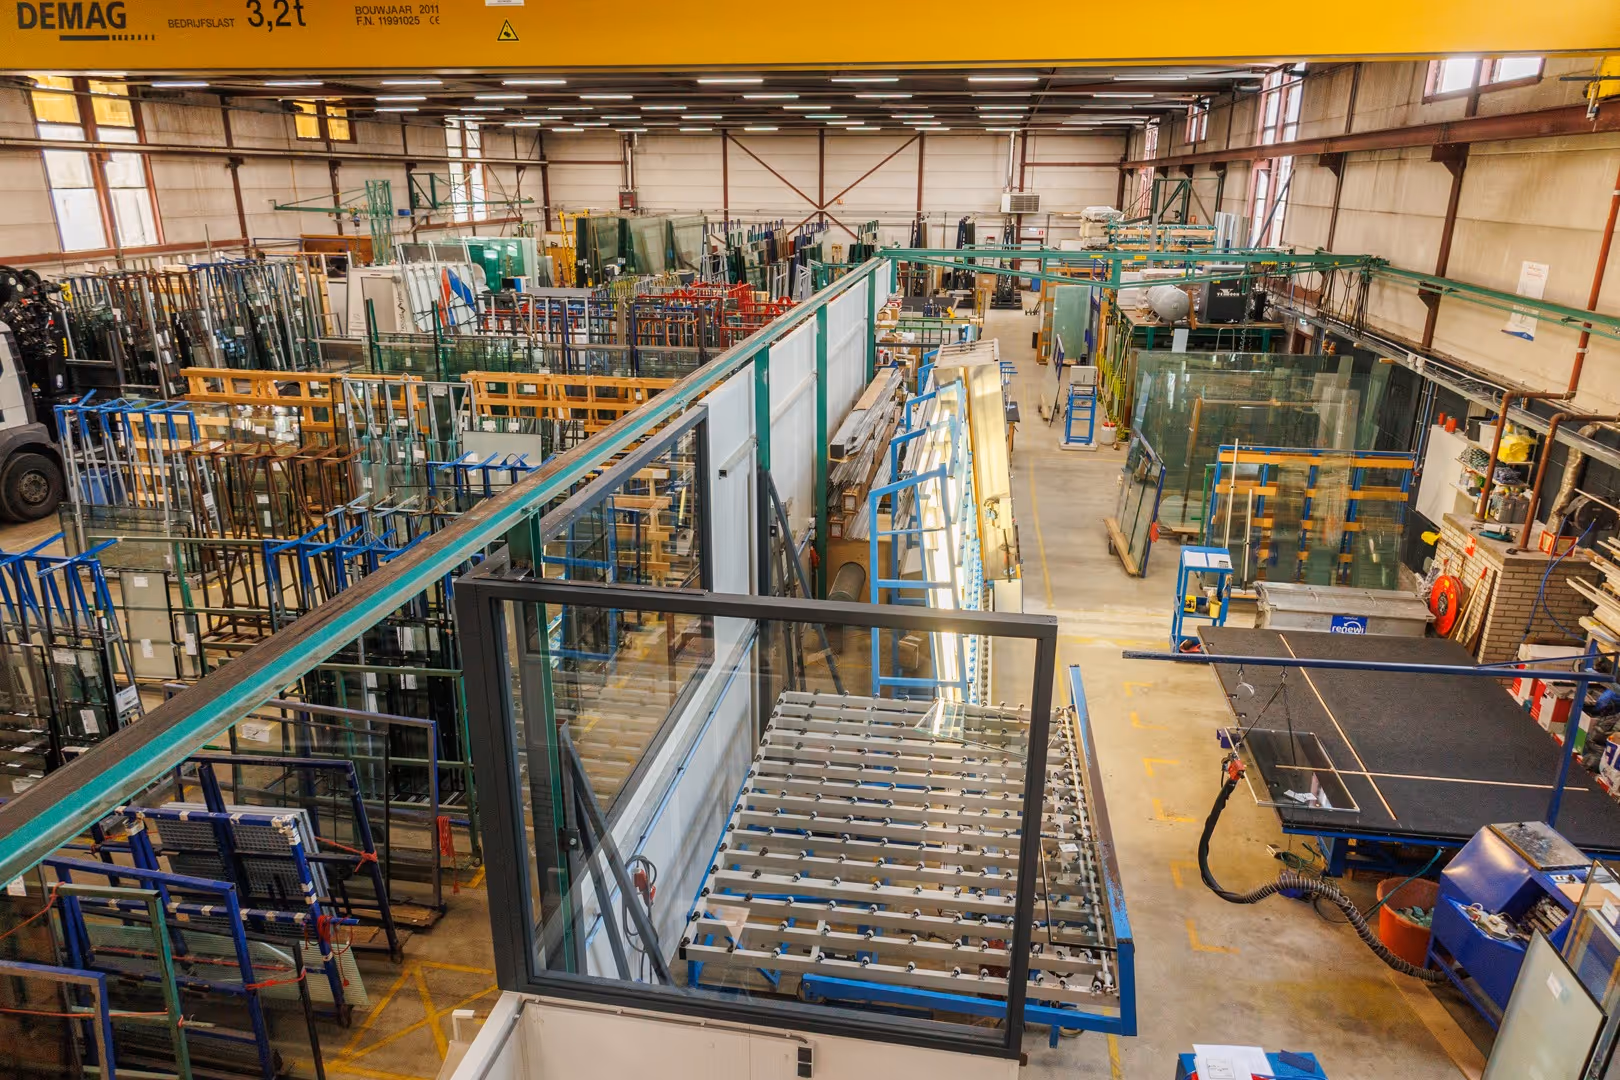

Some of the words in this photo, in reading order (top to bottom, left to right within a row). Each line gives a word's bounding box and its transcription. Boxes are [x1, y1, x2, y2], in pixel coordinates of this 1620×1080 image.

[355, 5, 412, 15] BOUWJAAR
[419, 5, 439, 14] 2011
[17, 2, 126, 29] DEMAG
[168, 19, 235, 28] BEDRIJFSLAST
[356, 17, 375, 25] F.N.
[379, 16, 420, 25] 11991025
[1332, 625, 1365, 634] renewi
